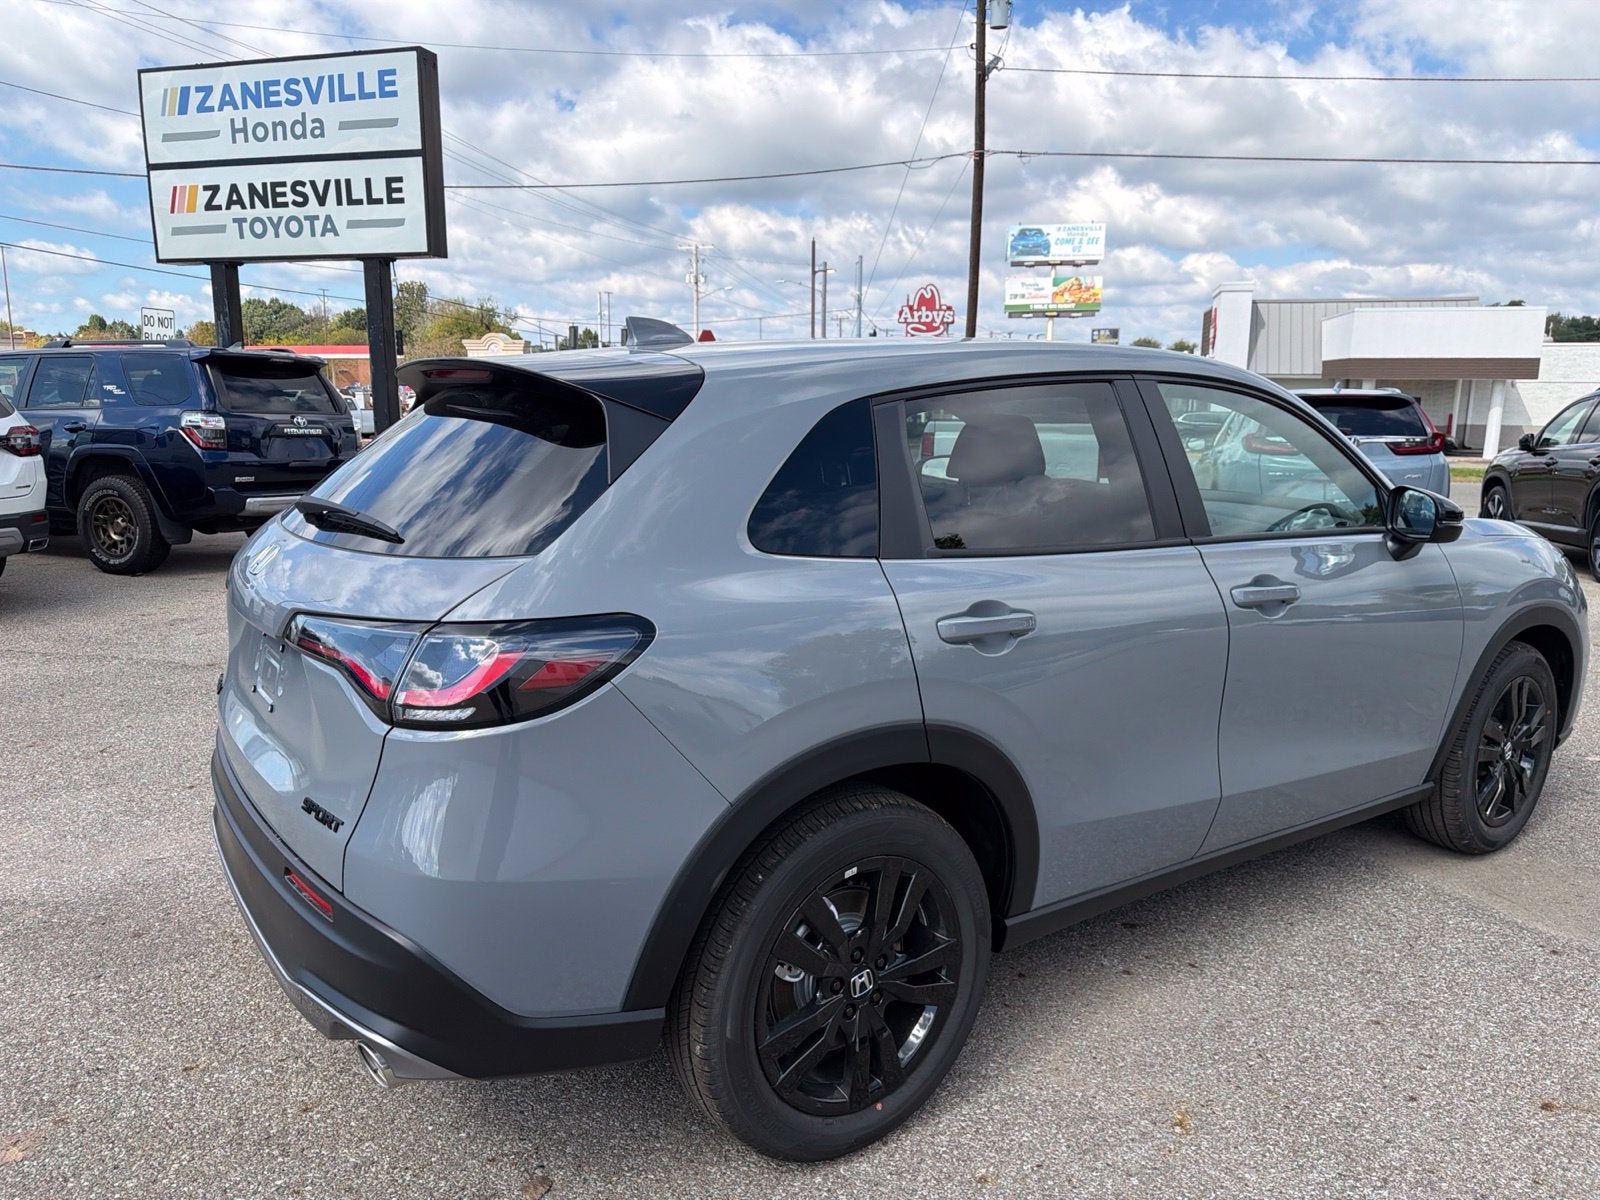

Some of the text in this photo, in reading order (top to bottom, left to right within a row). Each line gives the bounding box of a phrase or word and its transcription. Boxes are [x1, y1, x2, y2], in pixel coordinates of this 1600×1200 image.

[194, 68, 399, 114] ZANESVILLE
[230, 111, 326, 145] Honda
[202, 176, 406, 212] ZANESVILLE
[232, 214, 340, 240] TOYOTA
[1054, 237, 1075, 246] COME
[1086, 236, 1100, 245] SEE
[143, 315, 174, 329] DO NOT
[898, 304, 954, 327] Arby's
[301, 797, 345, 833] SPORT
